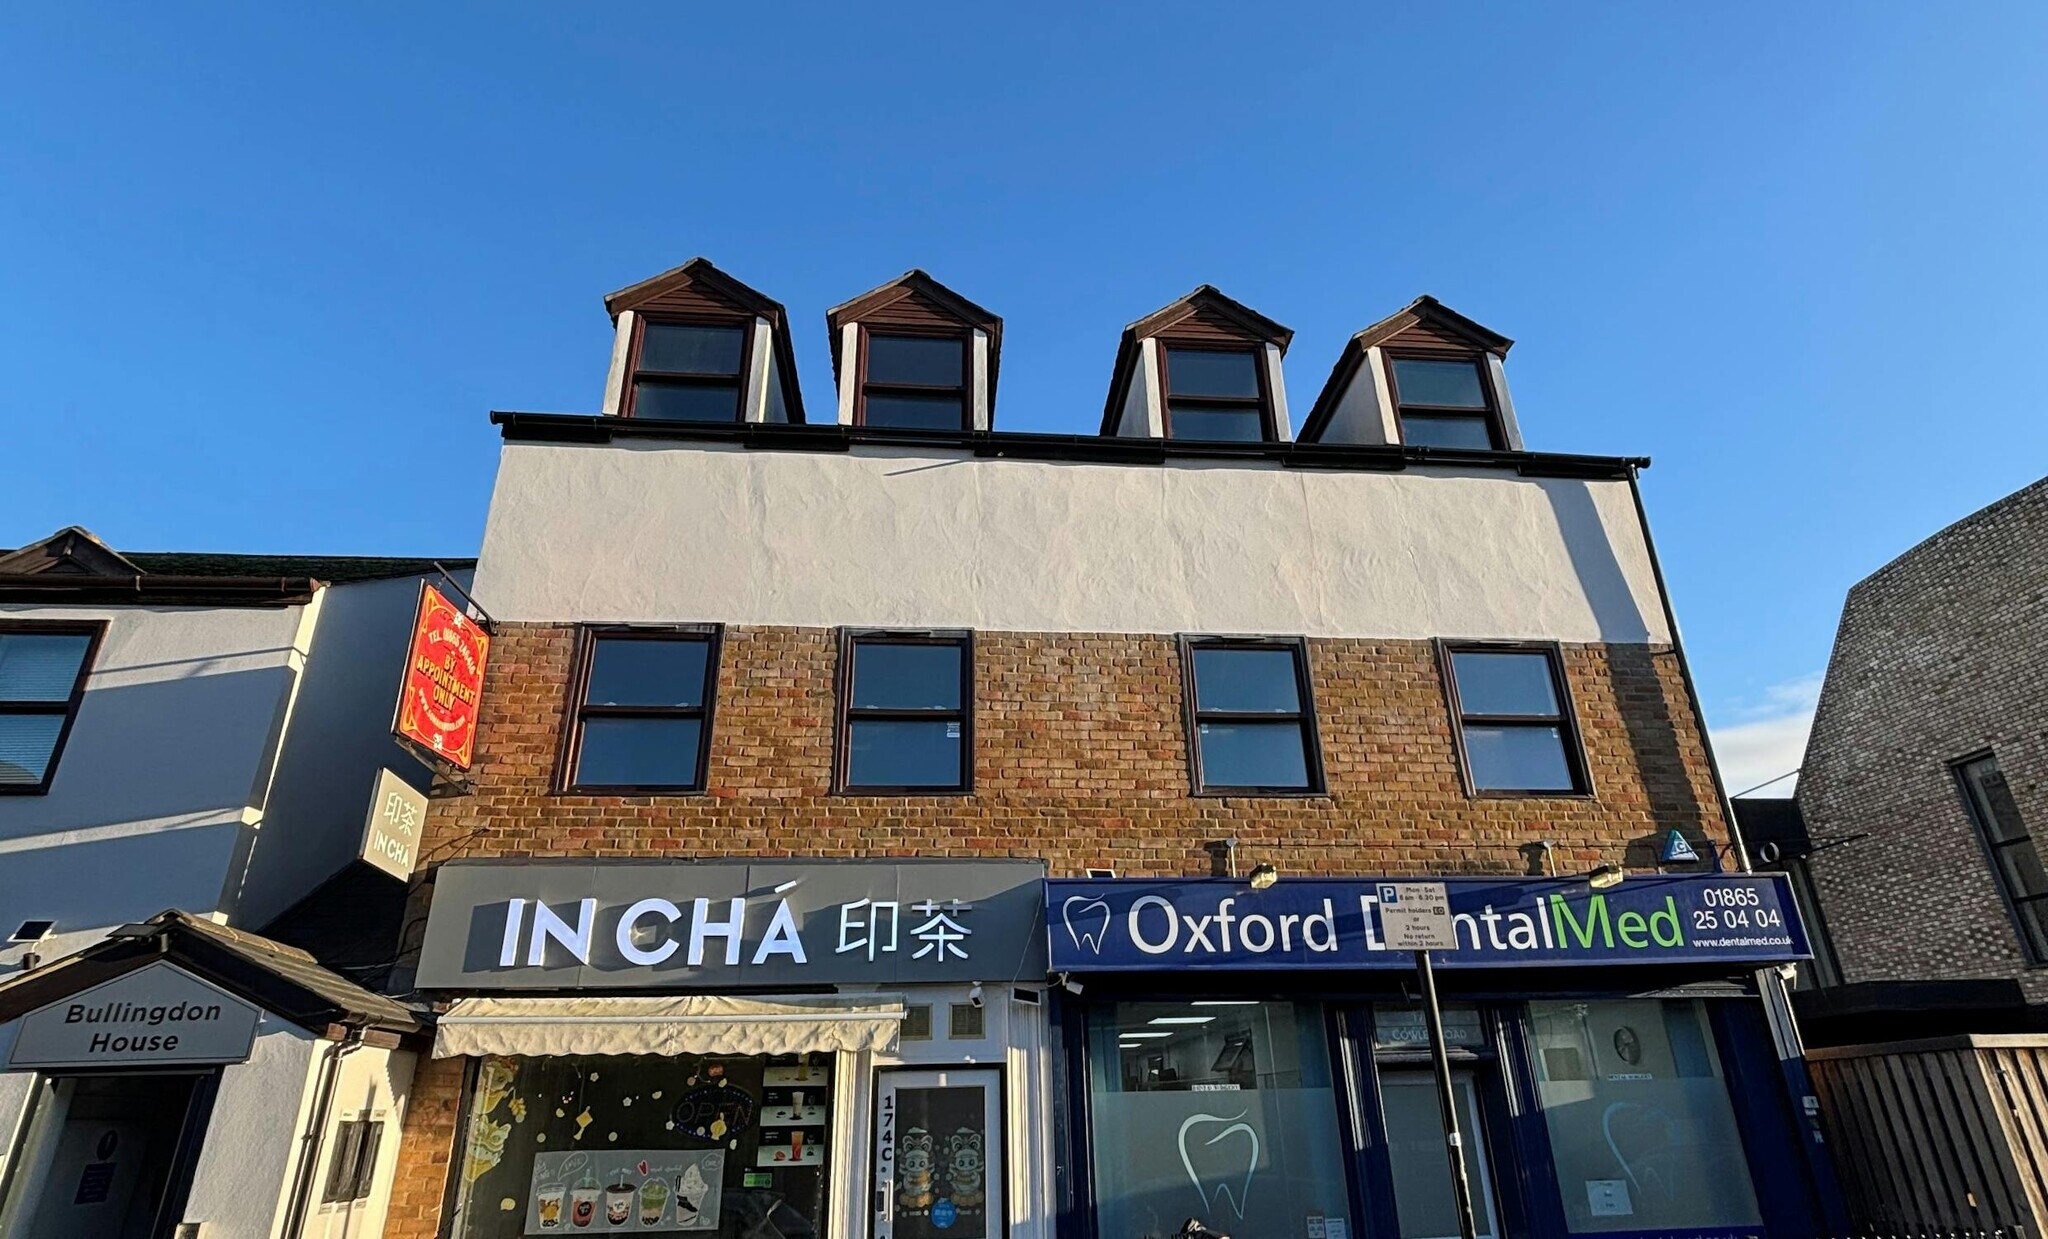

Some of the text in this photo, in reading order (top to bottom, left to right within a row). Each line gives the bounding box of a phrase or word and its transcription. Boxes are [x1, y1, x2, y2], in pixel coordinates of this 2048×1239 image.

[444, 654, 457, 673] BY
[416, 654, 476, 706] APPOINTMENT
[433, 684, 457, 711] ONLY
[384, 792, 417, 836] 印茶
[1703, 887, 1760, 907] 01865
[499, 880, 973, 967] IN CHÁ 印茶
[1128, 894, 1685, 954] Oxford DntalMed
[1693, 909, 1781, 930] 25 04 04
[1693, 936, 1795, 948] www.dentalmed.co.uk
[65, 1001, 221, 1025] Bullingdon
[89, 1033, 179, 1053] House
[1392, 1029, 1429, 1040] COWLE
[881, 1095, 894, 1162] 174C
